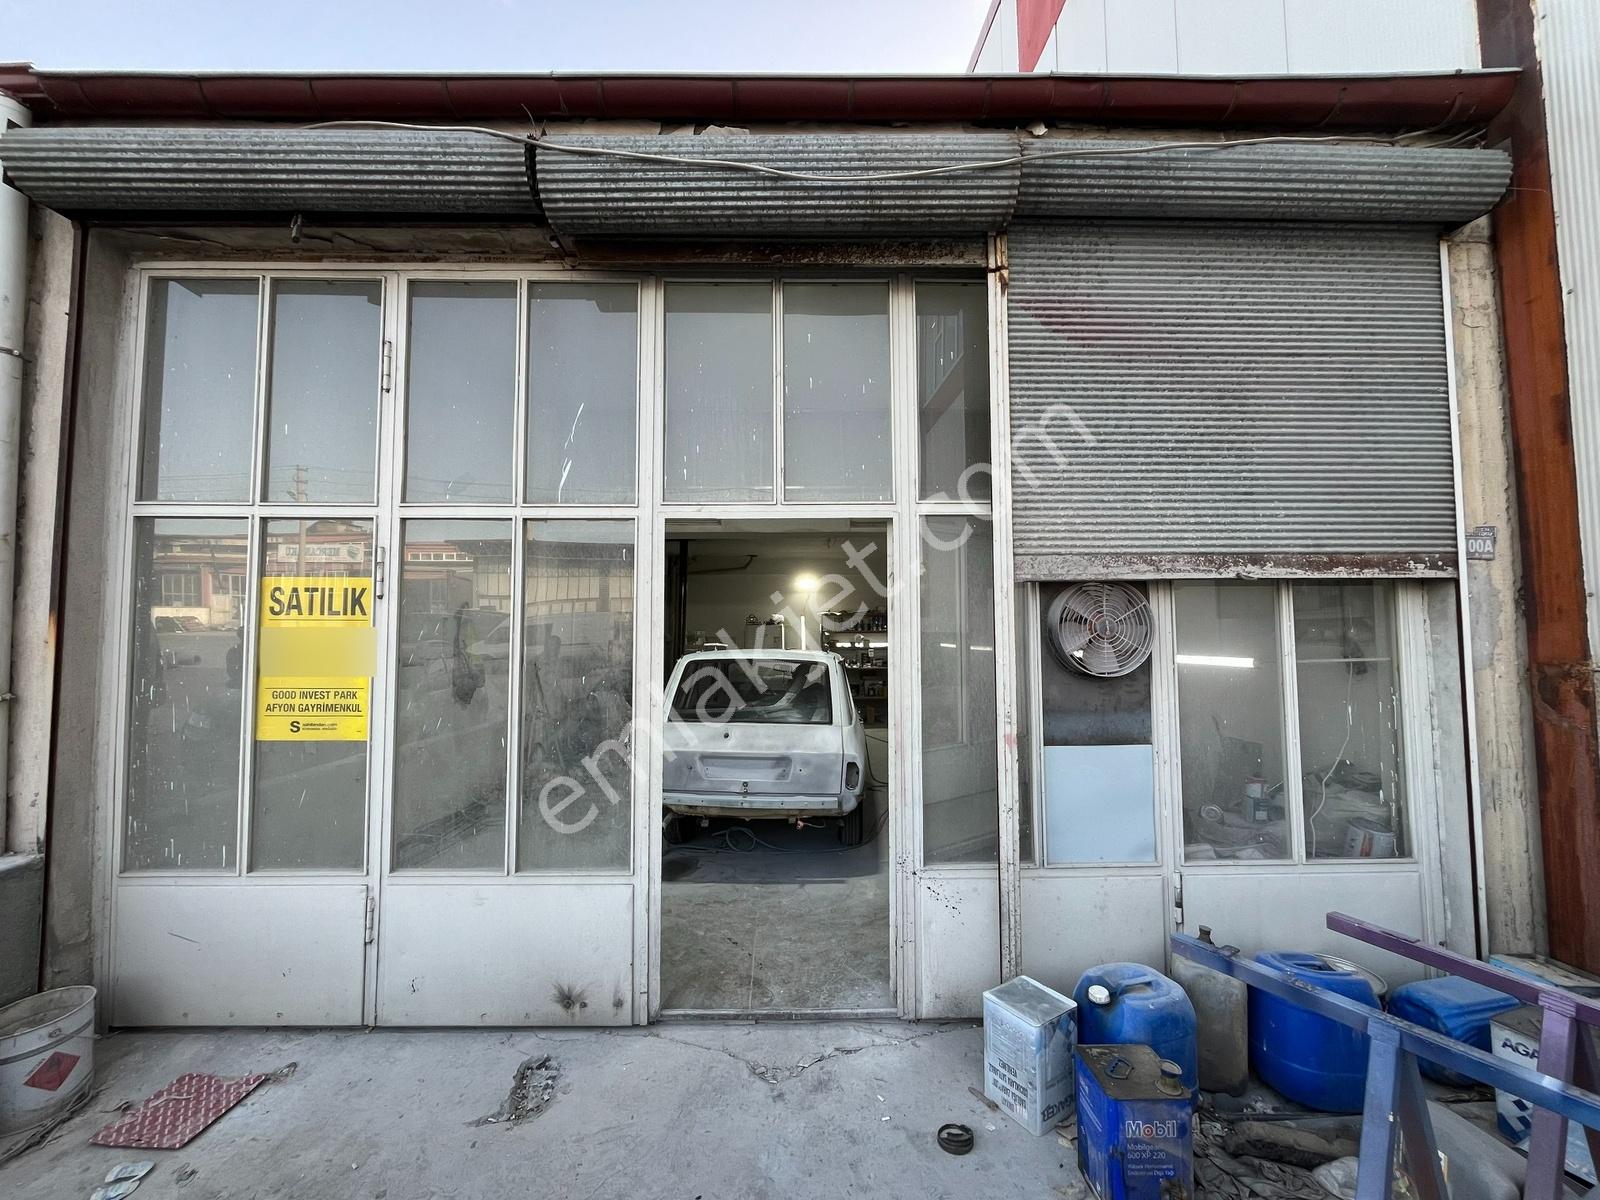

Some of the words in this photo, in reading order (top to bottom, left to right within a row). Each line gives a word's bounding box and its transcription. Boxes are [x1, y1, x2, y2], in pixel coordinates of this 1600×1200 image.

[269, 586, 367, 616] SATILIK
[272, 691, 296, 700] GOOD
[299, 691, 331, 700] INVEST
[334, 691, 358, 700] PARK
[265, 703, 296, 713] AFYON
[298, 702, 363, 713] GAYRİMENKUL
[1501, 1037, 1540, 1060] AGA
[1126, 1120, 1177, 1138] Mobil
[1153, 1151, 1166, 1159] 220
